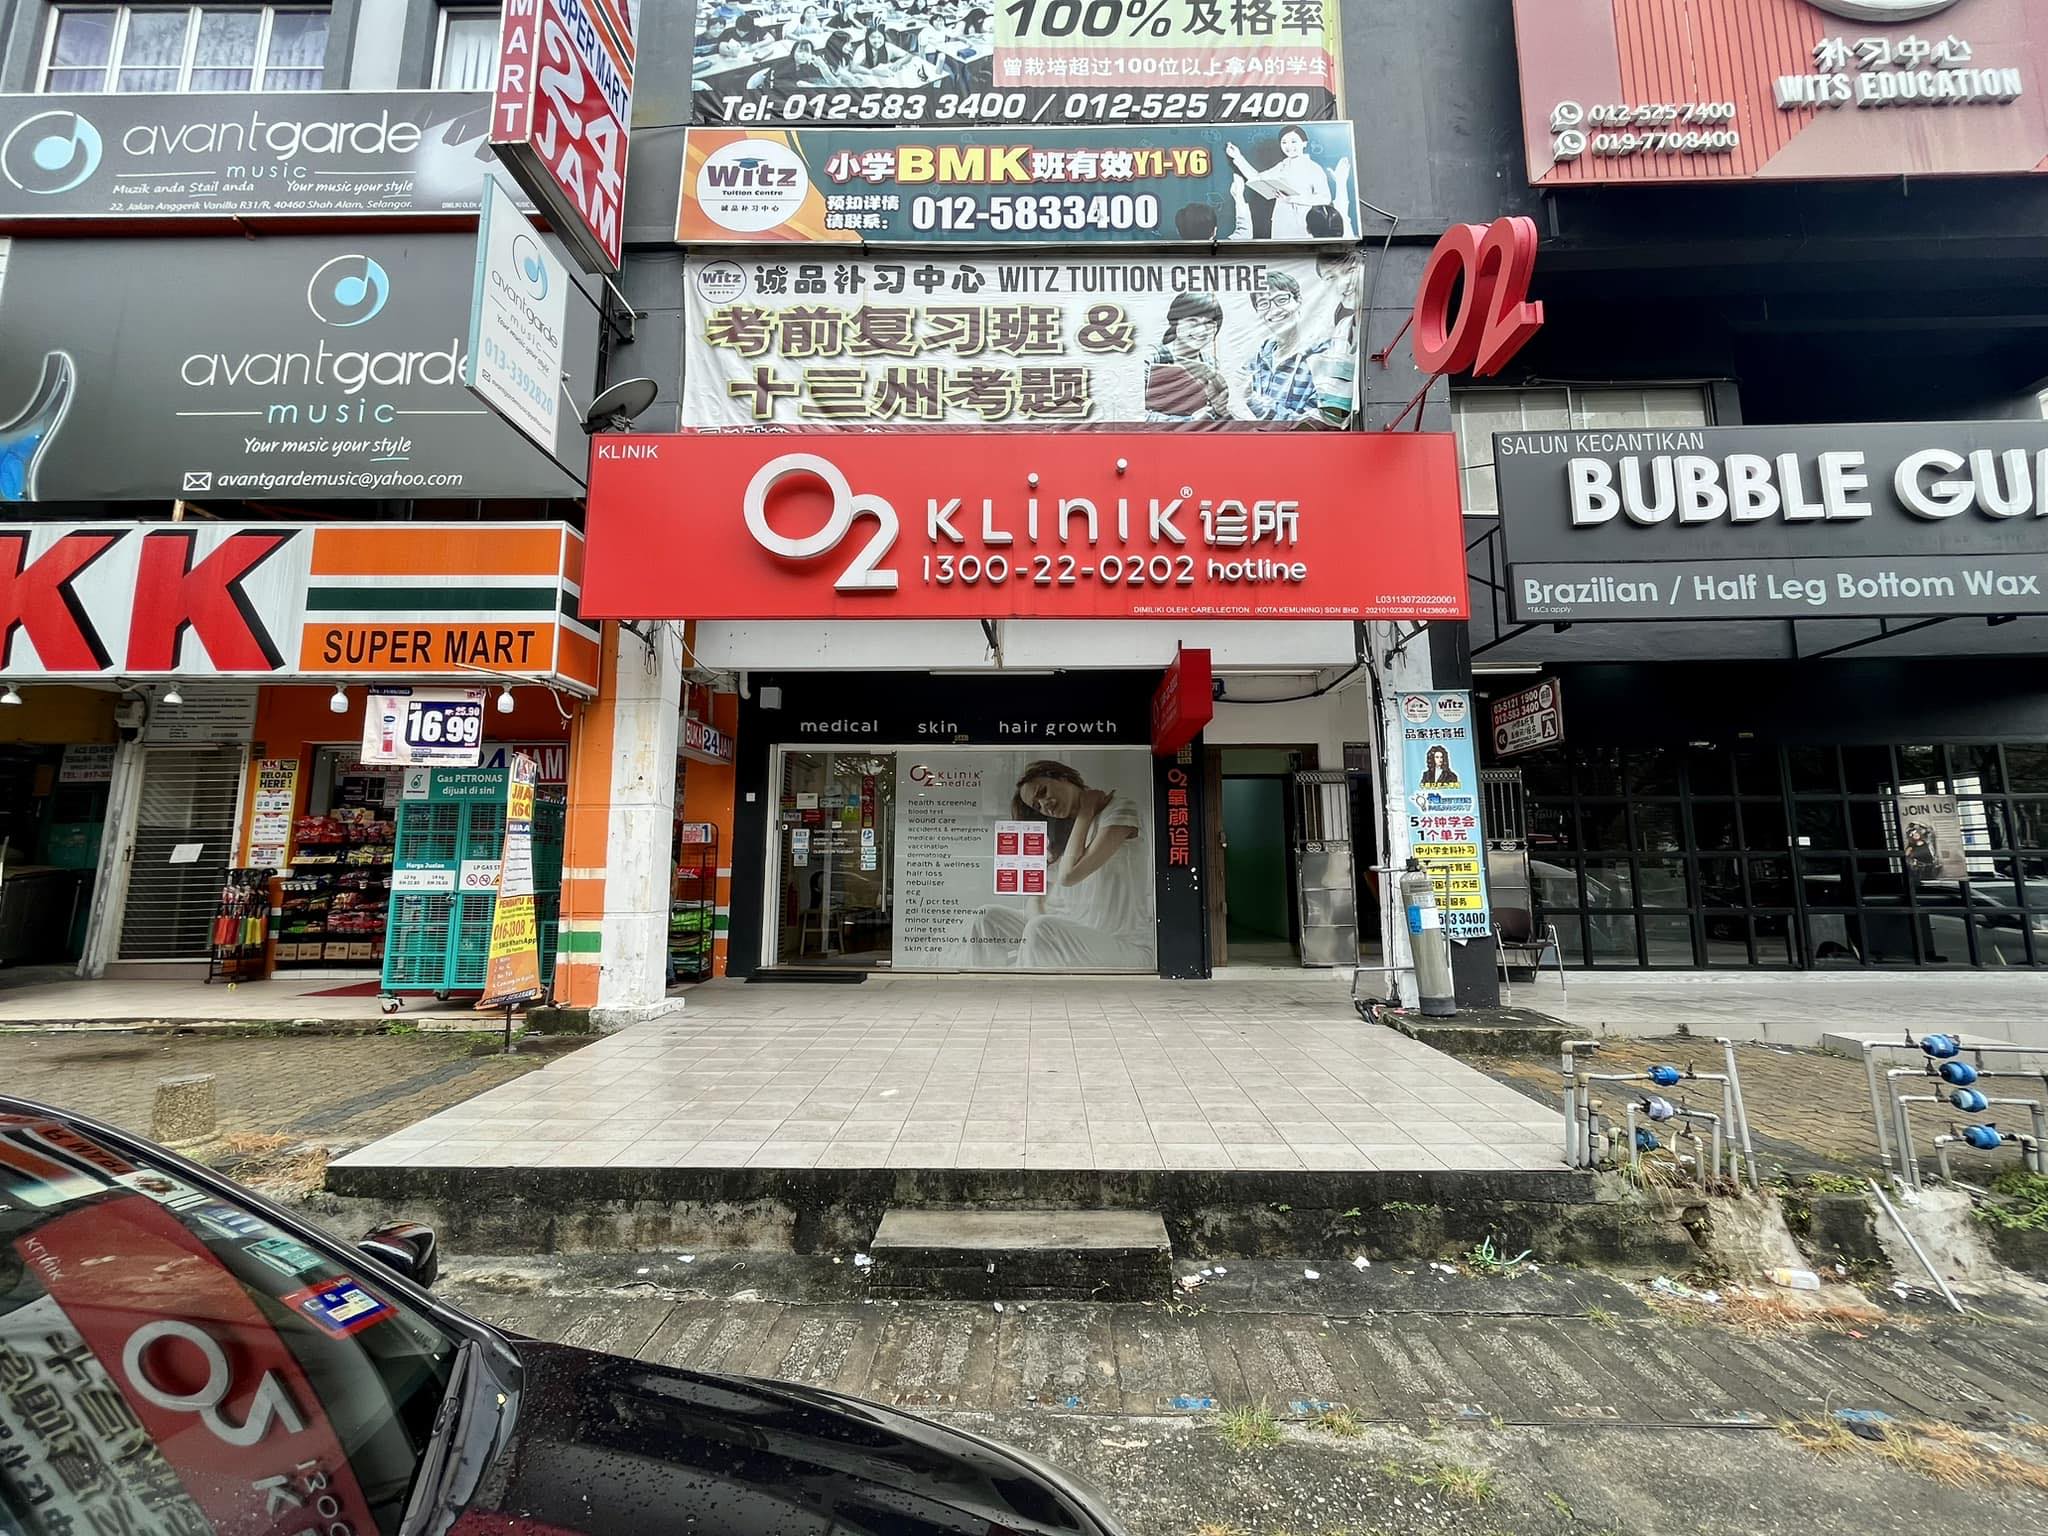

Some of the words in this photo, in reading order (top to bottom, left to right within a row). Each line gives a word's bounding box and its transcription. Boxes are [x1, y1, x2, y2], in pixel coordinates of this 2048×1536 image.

[1005, 0, 1172, 37] 100%
[1182, 0, 1325, 36] 及格率
[502, 0, 533, 132] MART
[1814, 34, 1974, 76] 补习中心
[593, 51, 628, 122] MART
[1773, 74, 1852, 110] WITS
[1857, 68, 2023, 107] EDUCATION
[540, 19, 621, 207] 24
[721, 96, 775, 121] Tel:
[783, 94, 924, 120] 012-583
[934, 92, 1028, 118] 3400
[1033, 93, 1056, 121] /
[1064, 93, 1208, 118] 012-525
[1220, 92, 1310, 118] 7400
[123, 109, 421, 159] avantgarde
[226, 161, 307, 179] music
[112, 182, 150, 195] Muzik
[153, 182, 185, 194] anda
[188, 180, 219, 196] Stail
[222, 181, 254, 192] anda
[286, 180, 314, 193] Your
[315, 180, 352, 193] music
[354, 182, 382, 195] your
[383, 180, 413, 197] style
[536, 112, 617, 257] JAM
[126, 202, 156, 212] Jalan
[156, 202, 201, 213] Anggerik
[203, 201, 238, 211] Vanilla
[274, 200, 305, 210] 40460
[307, 200, 333, 210] Shah
[826, 195, 900, 212] 预知详情
[911, 194, 1158, 230] 012-5833400
[754, 264, 987, 295] 诚品补习中心
[998, 266, 1060, 292] WITZ
[1066, 265, 1163, 292] TUITION
[1171, 264, 1269, 292] CENTRE
[705, 304, 1063, 357] 考前复习班
[1076, 303, 1136, 353] &
[485, 338, 553, 416] 013-3392820
[728, 367, 1094, 420] 十三州考题
[267, 400, 395, 424] music
[244, 437, 279, 455] Your
[281, 437, 328, 454] music
[330, 439, 369, 458] your
[371, 436, 411, 458] style
[598, 445, 658, 459] KLINIK
[1501, 436, 1569, 455] SALUN
[1576, 432, 1705, 452] KECANTIKAN
[218, 470, 463, 490] avantgardemusic@yahoo.com
[1567, 451, 1873, 526] BUBBLE
[1893, 448, 2048, 519] GU
[1199, 500, 1300, 546] 诊所
[921, 554, 1195, 585] 1300-22-0202
[1206, 557, 1308, 583] hotline
[1523, 576, 1659, 604] Brazilian
[1669, 575, 1682, 605] /
[1693, 574, 1758, 601] Half
[1767, 574, 1827, 606] Leg
[1836, 572, 1955, 599] Bottom
[1961, 570, 2041, 596] Wax
[1190, 606, 1250, 615] CARELLECTION
[1324, 606, 1342, 615] SDN
[323, 630, 431, 664] SUPER
[443, 629, 536, 664] MART
[408, 709, 480, 743] 16.99
[799, 719, 878, 733] medical
[917, 719, 958, 734] skin
[999, 719, 1038, 733] hair
[1045, 719, 1118, 737] growth
[703, 729, 719, 755] 24
[259, 779, 286, 788] HERE
[261, 771, 293, 779] RELOAD
[437, 774, 453, 783] Gas
[454, 774, 503, 783] PETRONAS
[442, 786, 468, 796] dijual
[468, 786, 478, 795] di
[479, 786, 495, 796] sini
[908, 799, 935, 807] health
[937, 799, 977, 808] screening
[1902, 803, 1931, 817] JOIN
[1932, 802, 1956, 814] US!
[1410, 816, 1475, 829] 5分钟学会
[1418, 829, 1468, 842] 1个单元
[906, 889, 921, 897] ecg
[904, 936, 960, 944] hypertension
[969, 936, 1006, 944] diabetes
